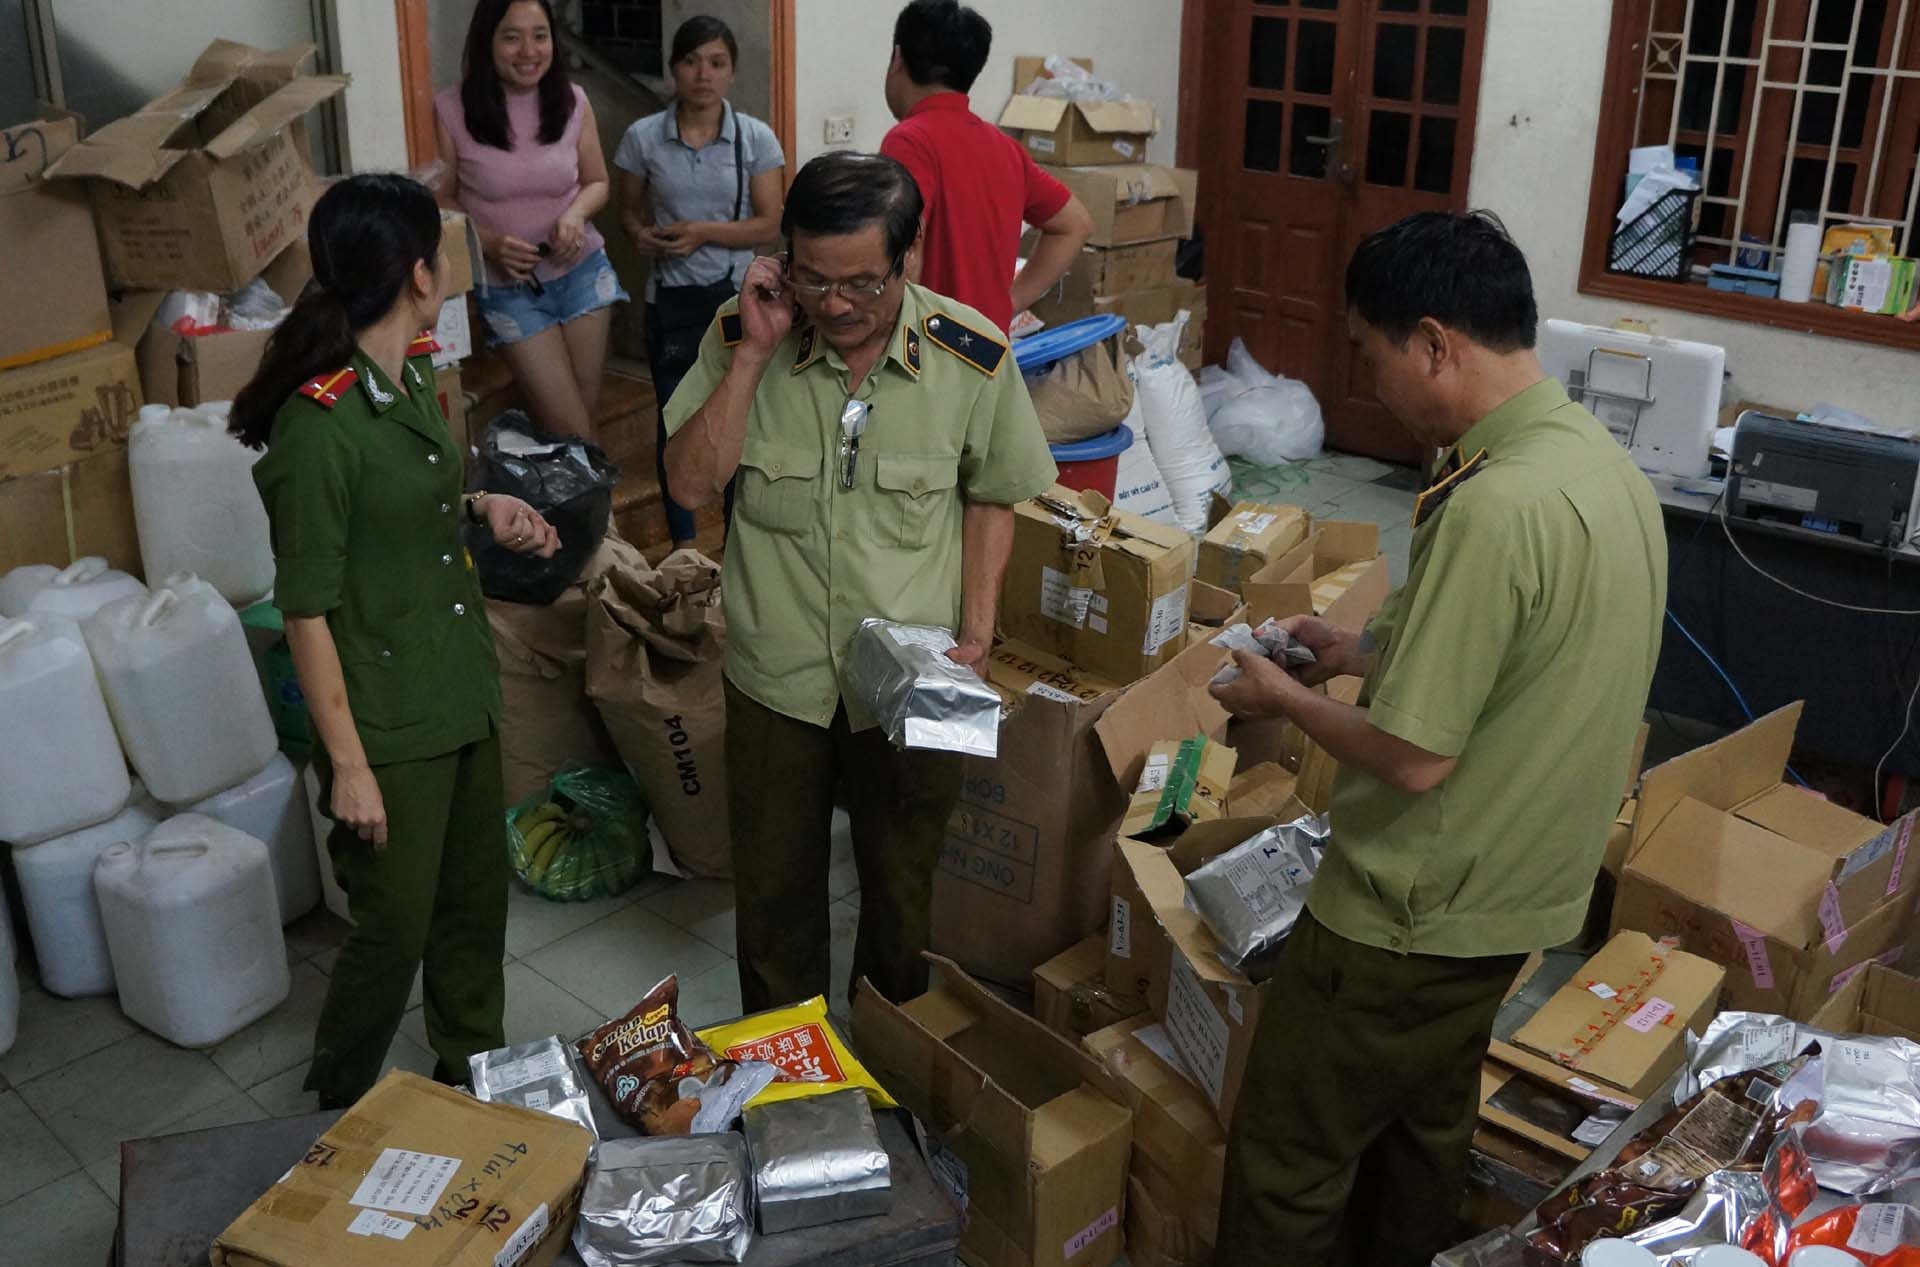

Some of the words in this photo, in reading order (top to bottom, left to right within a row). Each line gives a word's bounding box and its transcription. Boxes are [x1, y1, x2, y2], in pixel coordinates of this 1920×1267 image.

[664, 714, 702, 797] CM104
[592, 1015, 643, 1061] Santan
[775, 1047, 808, 1066] KYO
